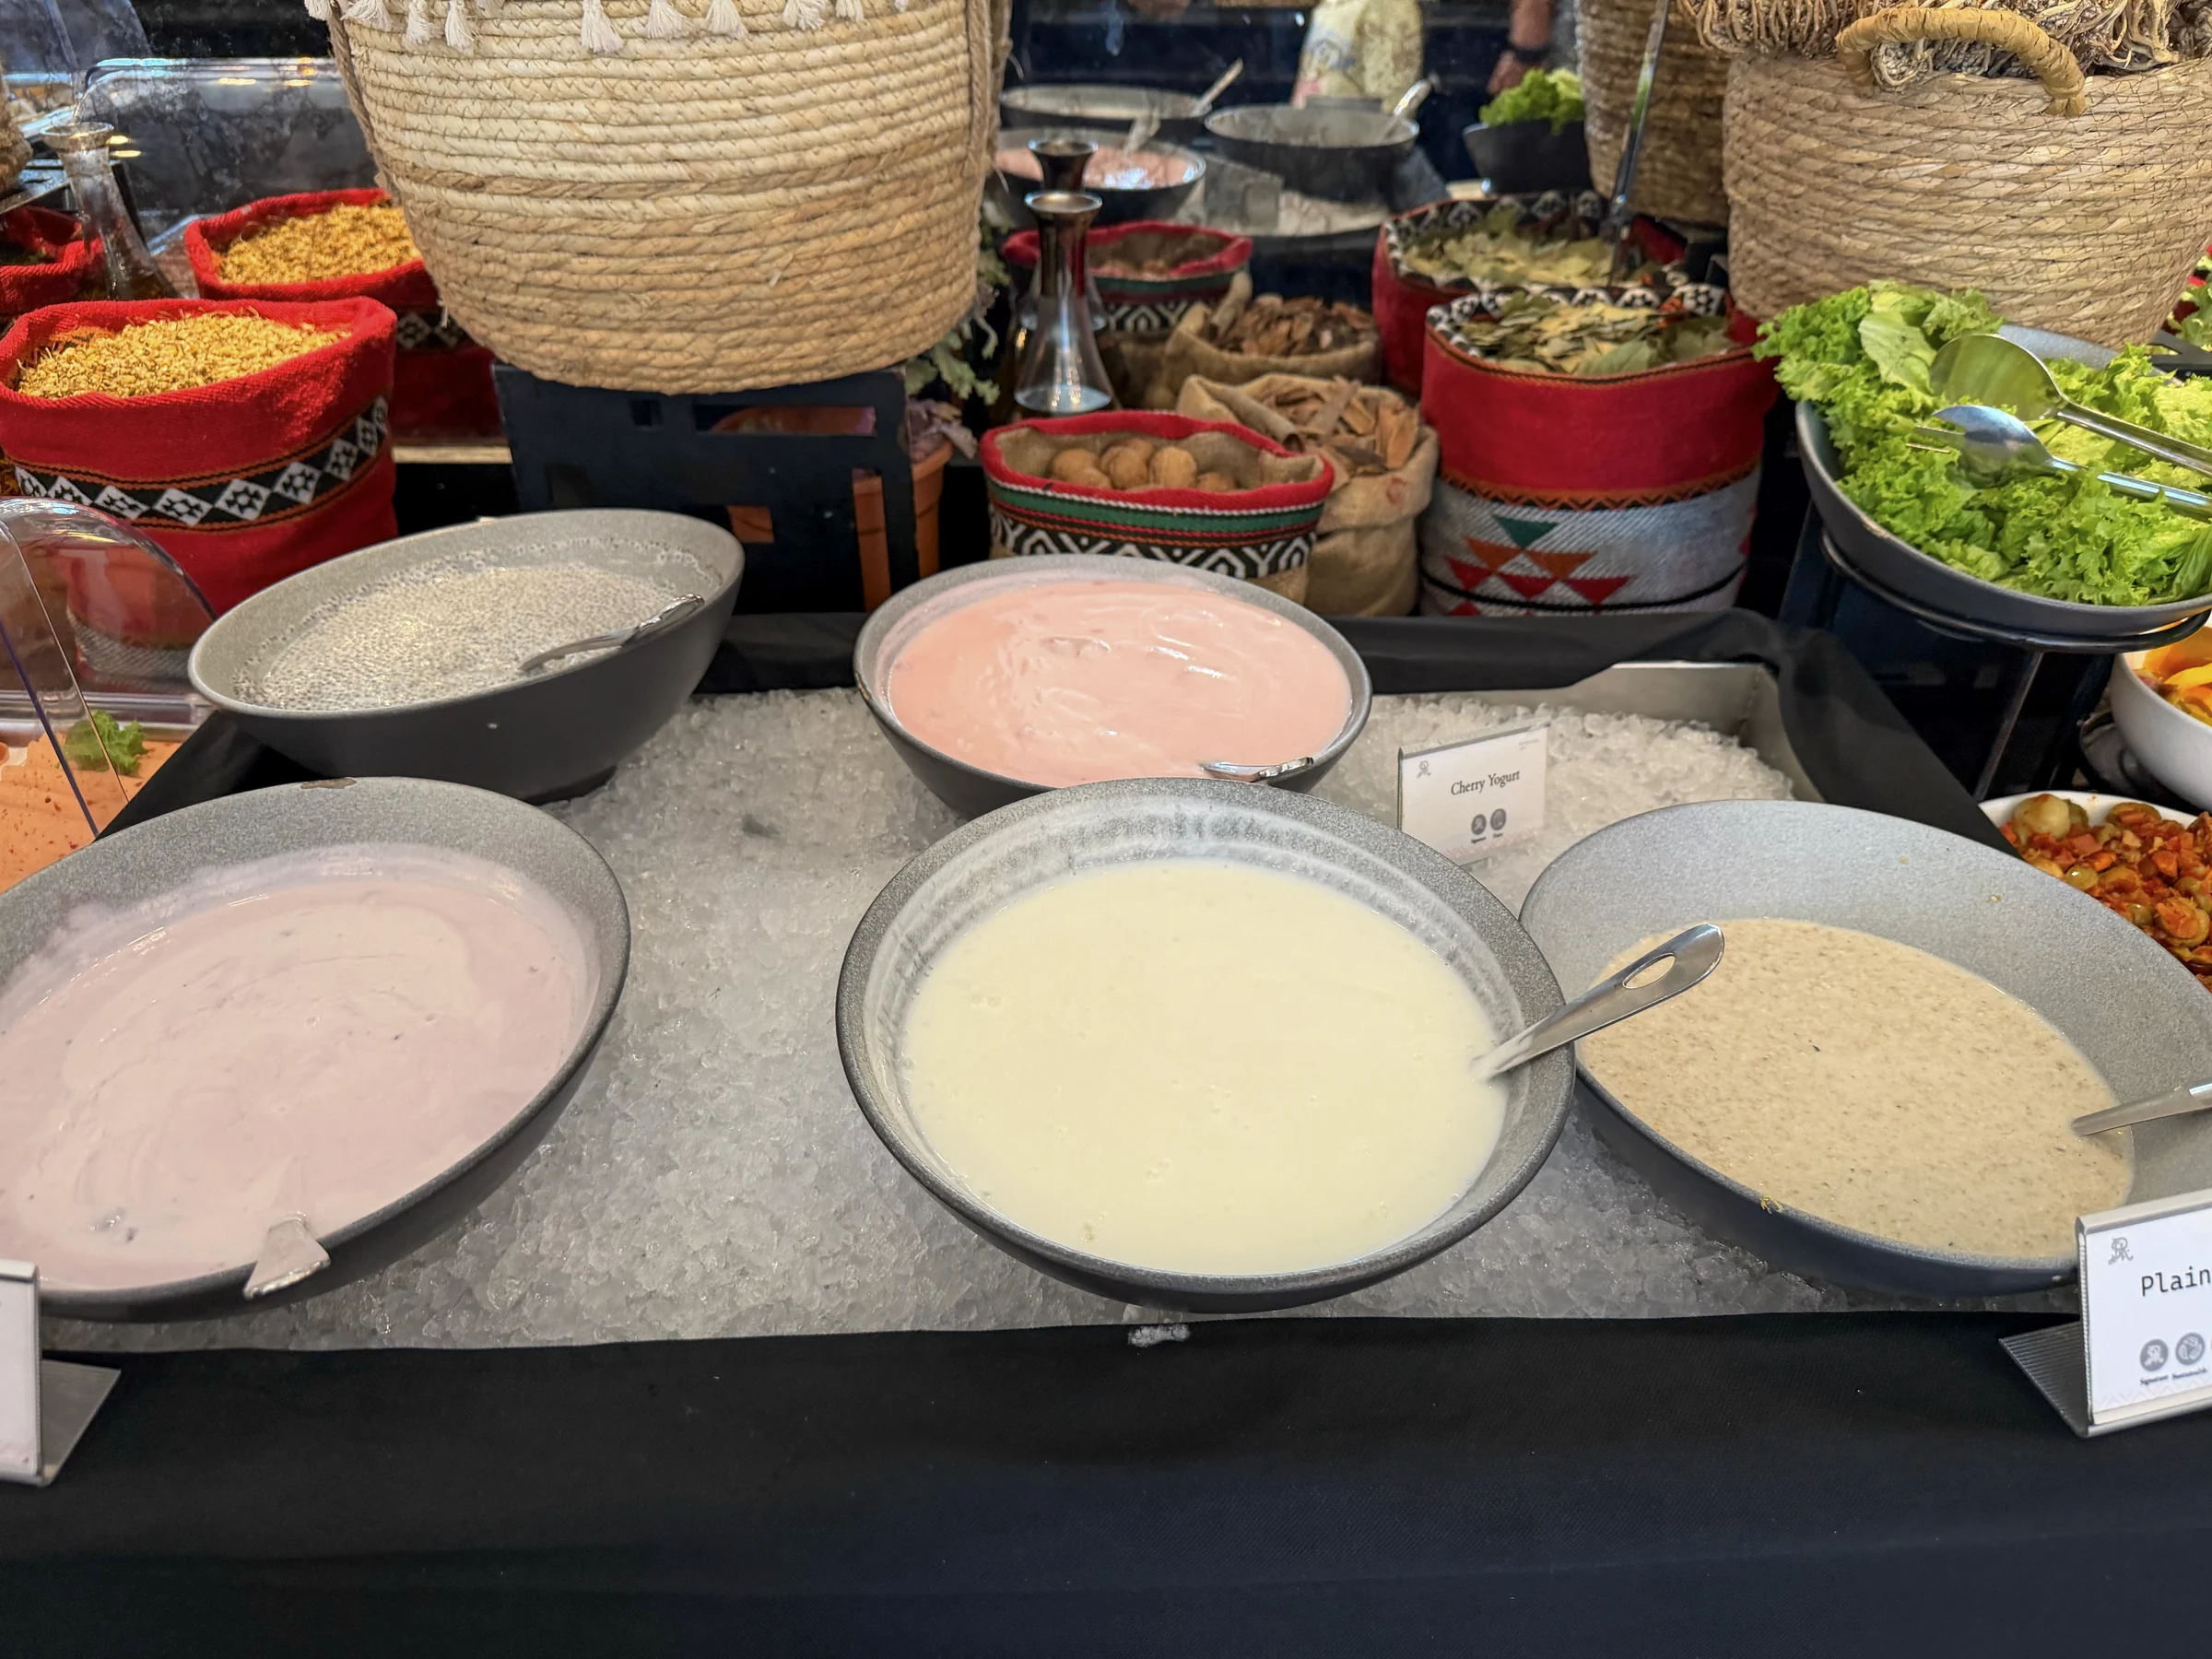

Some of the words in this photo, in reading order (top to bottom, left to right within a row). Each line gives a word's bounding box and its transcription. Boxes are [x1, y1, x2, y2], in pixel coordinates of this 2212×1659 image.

[1451, 780, 1486, 795] Cherry
[1488, 771, 1520, 788] Yogurt
[2141, 1265, 2211, 1297] Plain
